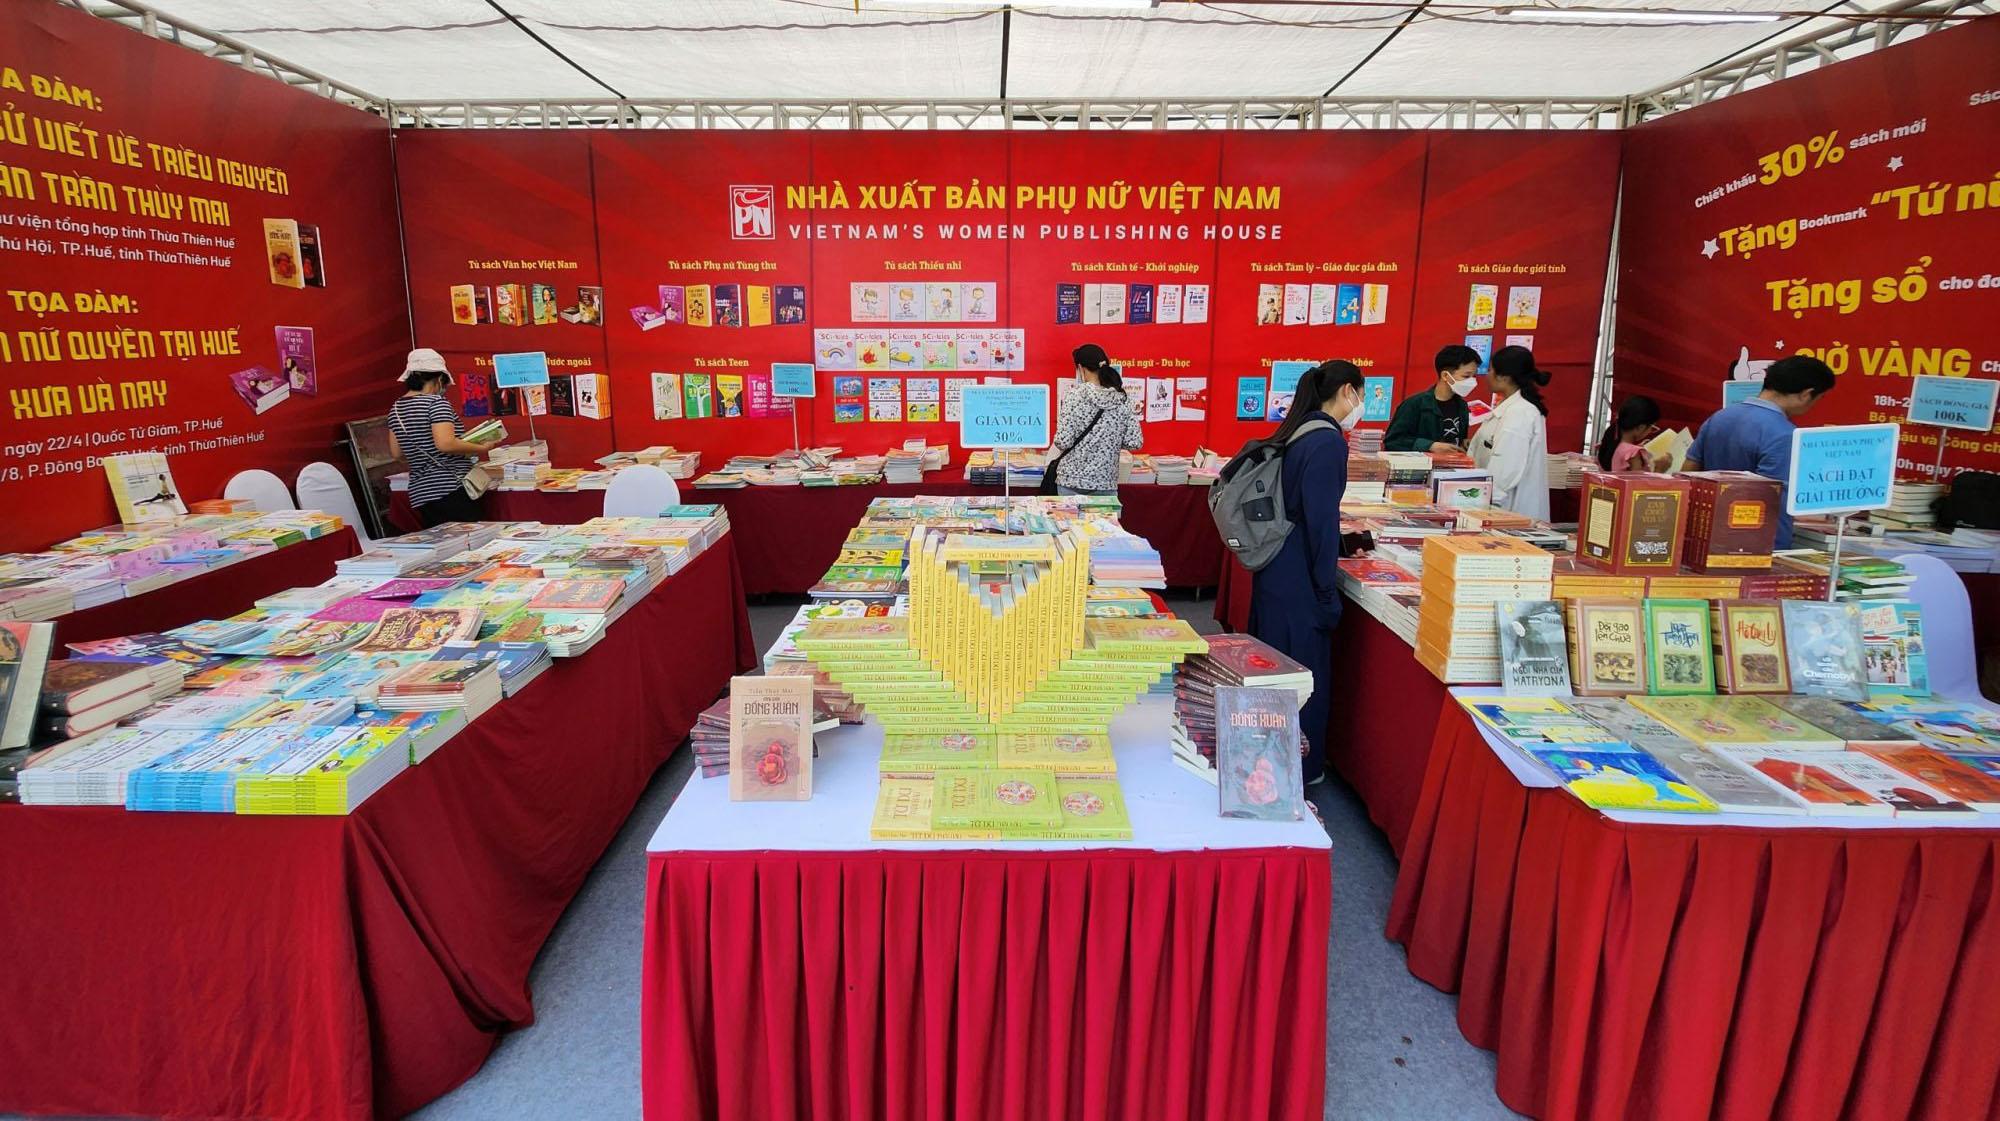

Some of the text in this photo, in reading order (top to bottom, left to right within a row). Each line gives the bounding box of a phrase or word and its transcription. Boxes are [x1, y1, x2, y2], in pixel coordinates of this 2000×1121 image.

[30, 75, 103, 112] ĐÀM:
[1694, 118, 1927, 208] Chiết khấu 30% sách mới
[217, 158, 289, 195] NGUYỄN
[41, 169, 117, 212] TRẦN
[122, 184, 183, 220] THÙY
[189, 196, 231, 227] MAI
[787, 178, 1281, 214] NHÀ XUẤT BẢN PHỤ NỮ VIỆT NAM
[17, 213, 51, 231] viện
[55, 216, 89, 236] tổng
[92, 222, 118, 239] hợp
[149, 229, 179, 243] Thừa
[182, 232, 212, 246] Thiên
[215, 237, 235, 249] Huế
[939, 224, 1025, 239] WOMEN
[1040, 224, 1189, 240] PUBLISHING
[1204, 224, 1282, 240] HOUSE
[1718, 218, 1797, 259] Tặng
[1799, 207, 1867, 230] Bookmark
[26, 238, 55, 255] Hội,
[210, 256, 231, 268] Huế
[468, 260, 577, 270] Tủ sách Văn học Việt Nam
[668, 260, 680, 270] Tủ
[682, 260, 701, 270] sách
[703, 260, 721, 271] Phụ
[737, 260, 759, 271] Tùng
[885, 260, 962, 270] Tủ sách Thiếu nhi
[1071, 262, 1199, 274] Tủ sách Kinh tế Khởi nghiệp
[1251, 262, 1398, 273] Tủ sách Tâm lý Giáo dục gia đình
[1458, 264, 1566, 275] Tủ sách Giáo dục giới tính
[1766, 277, 1862, 319] Tặng
[1871, 256, 1932, 303] sổ
[1939, 276, 1974, 290] cho
[7, 289, 139, 318] TỌA ĐÀM:
[18, 326, 62, 362] NỮ
[67, 324, 155, 360] QUYỀN
[160, 330, 197, 361] TẠI
[201, 324, 241, 355] HUẾ
[568, 357, 591, 367] ngoài
[694, 358, 749, 367] Tủ sách Teen
[1161, 359, 1173, 367] Du
[1175, 359, 1191, 368] học
[1859, 340, 1972, 377] VÀNG
[10, 385, 72, 420] XƯA
[120, 380, 168, 410] NAY
[1874, 395, 1913, 408] 18h-2
[1017, 412, 1042, 426] GIÁ
[1934, 410, 1967, 422] 100K
[5, 441, 43, 457] ngày
[48, 435, 82, 451] 22/4
[92, 429, 126, 446] Quốc
[148, 425, 180, 438] Giám,
[184, 417, 223, 432] TP.Huế
[247, 430, 265, 442] Huế
[994, 431, 1023, 442] 30%
[1900, 432, 1918, 446] ậu
[1921, 434, 1937, 446] và
[1808, 467, 1876, 482] SÁCH ĐẠT
[1513, 675, 1565, 687] MATRYONA
